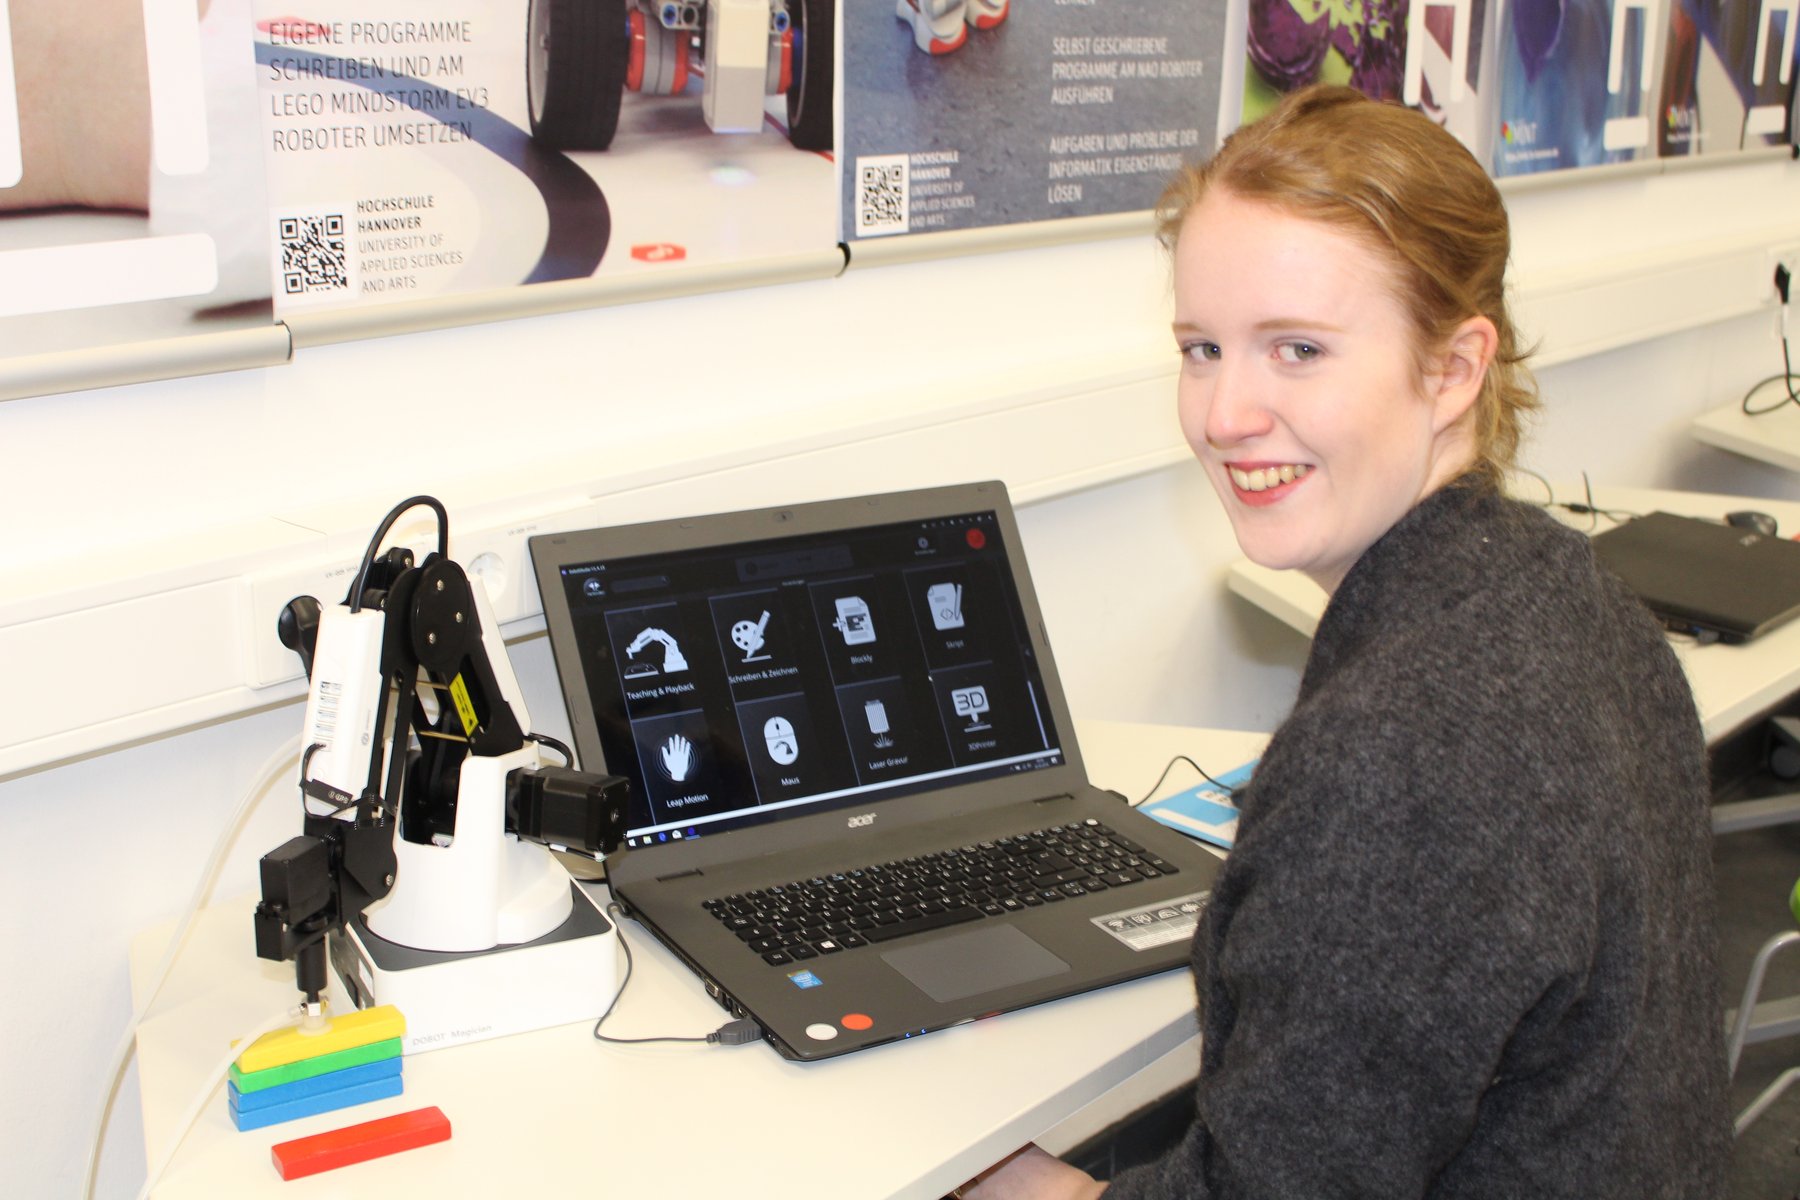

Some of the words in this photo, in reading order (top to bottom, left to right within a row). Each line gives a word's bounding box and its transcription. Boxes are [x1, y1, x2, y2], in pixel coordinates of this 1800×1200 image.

[269, 22, 344, 46] EIGENE
[351, 20, 472, 44] PROGRAMME
[1052, 37, 1091, 55] SELBST
[1093, 36, 1168, 55] GESCHRIEBENE
[269, 56, 385, 81] SCHREIBEN
[391, 55, 431, 78] UND
[436, 55, 464, 76] AM
[1052, 61, 1118, 80] PROGRAMME
[1119, 61, 1137, 78] AM
[1160, 60, 1204, 78] ROBOTER
[271, 93, 324, 117] LEGO
[330, 89, 450, 115] MINDSTORM
[456, 87, 489, 110] EV3
[273, 126, 367, 152] ROBOTER
[373, 121, 473, 147] UMSETZEN
[1050, 134, 1105, 154] AUFGABEN
[1106, 133, 1128, 151] UND
[1129, 130, 1179, 149] PROBLEME
[1179, 128, 1199, 147] DER
[1048, 157, 1113, 179] INFORMATIK
[1047, 182, 1083, 204] LÖSEN
[356, 195, 435, 213] HOCHSCHULE
[357, 216, 422, 234] HANNOVER
[358, 235, 426, 254] UNIVERSITY
[429, 234, 444, 248] OF
[359, 256, 408, 274] APPLIED
[410, 251, 464, 269] SCIENCES
[361, 279, 385, 294] AND
[388, 275, 417, 290] ARTS
[946, 639, 965, 649] Skript
[850, 654, 873, 664] Blockly
[728, 673, 761, 685] Schreiben
[762, 671, 768, 679] &
[769, 667, 798, 678] Zeichnen
[626, 689, 658, 701] Teaching
[659, 687, 665, 696] &
[665, 682, 695, 696] Playback
[868, 762, 886, 771] Laser
[887, 756, 908, 768] Gravur
[781, 777, 800, 786] Maus
[666, 799, 683, 809] Leap
[683, 793, 709, 805] Motion
[847, 812, 877, 828] acer
[412, 1032, 446, 1046] DOBOT
[450, 1025, 492, 1039] Magician
